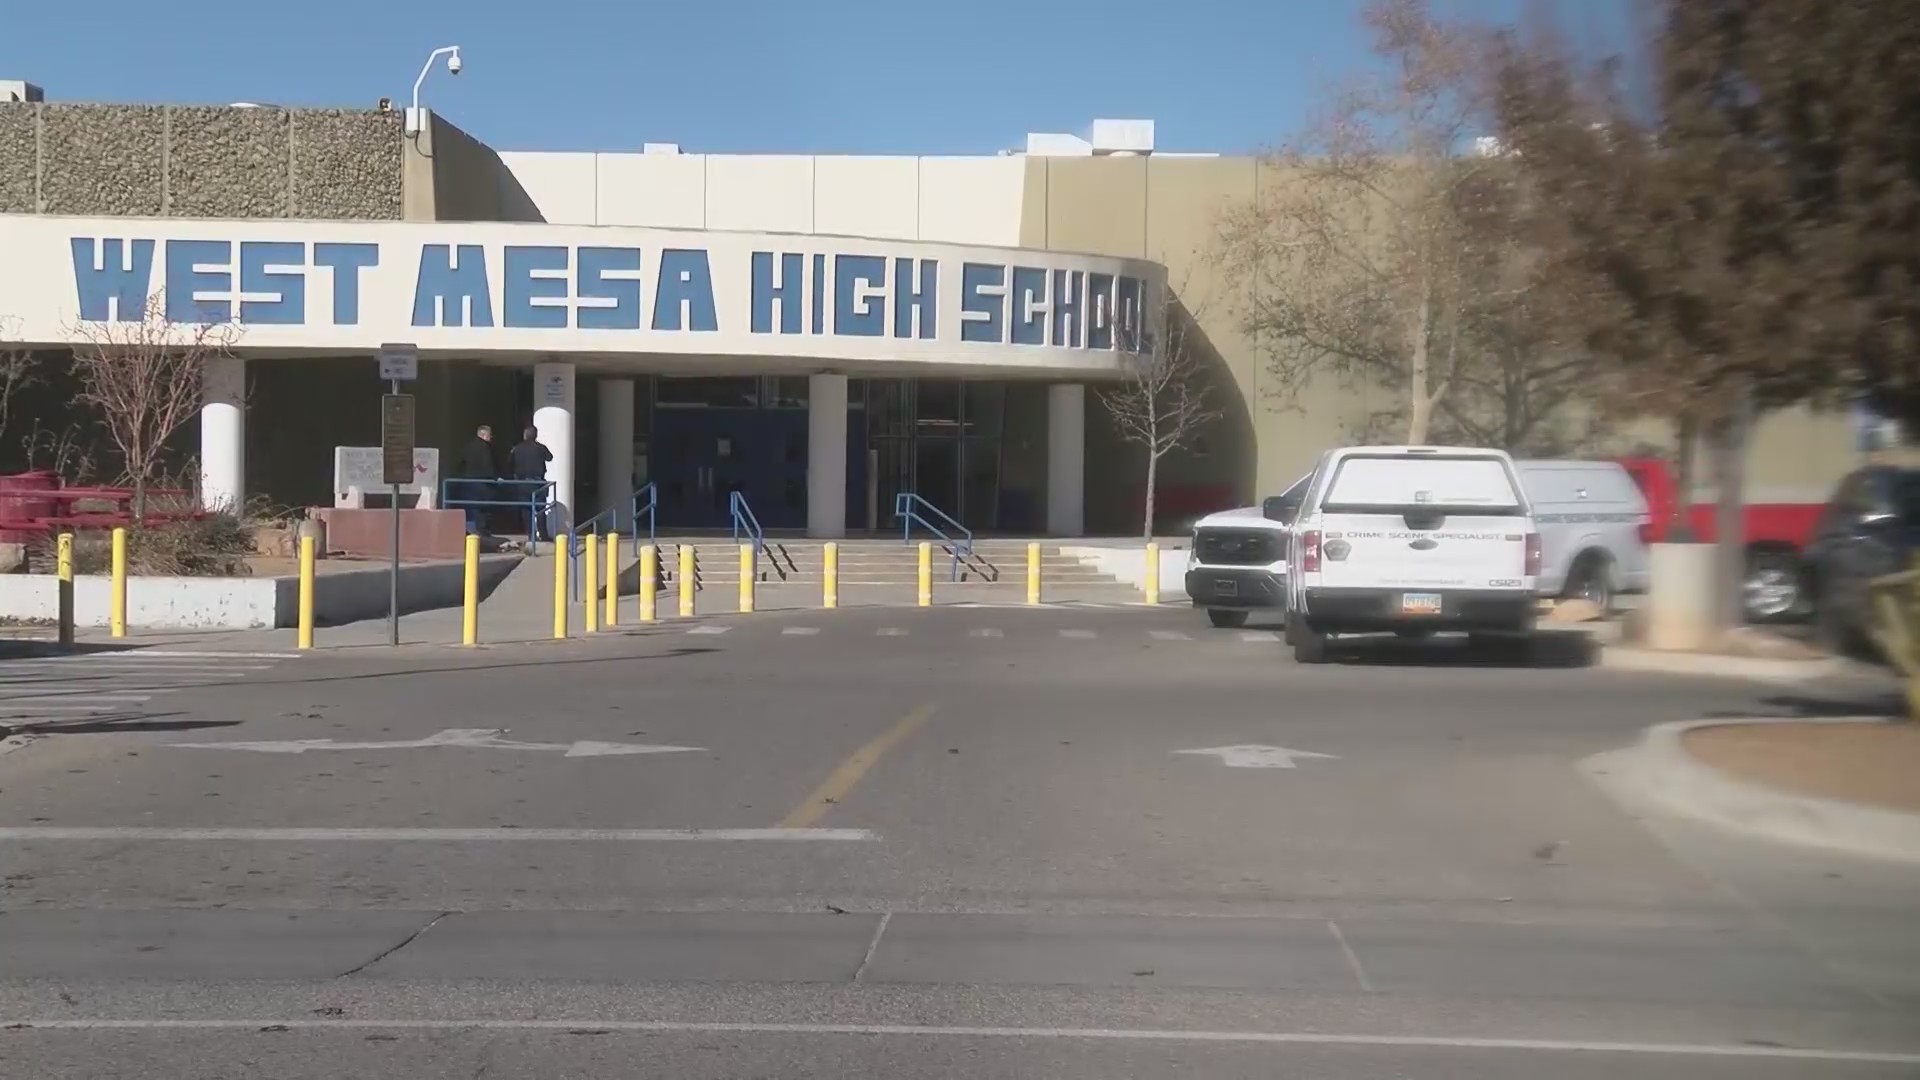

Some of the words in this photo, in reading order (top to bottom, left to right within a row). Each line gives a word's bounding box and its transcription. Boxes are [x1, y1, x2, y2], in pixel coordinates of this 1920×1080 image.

[71, 238, 379, 325] WEST
[411, 244, 718, 332] MESA
[751, 251, 939, 340] HIGH
[961, 262, 1152, 354] SCHOOL
[1346, 531, 1384, 539] CRIME
[1432, 532, 1501, 541] SPECIALIST
